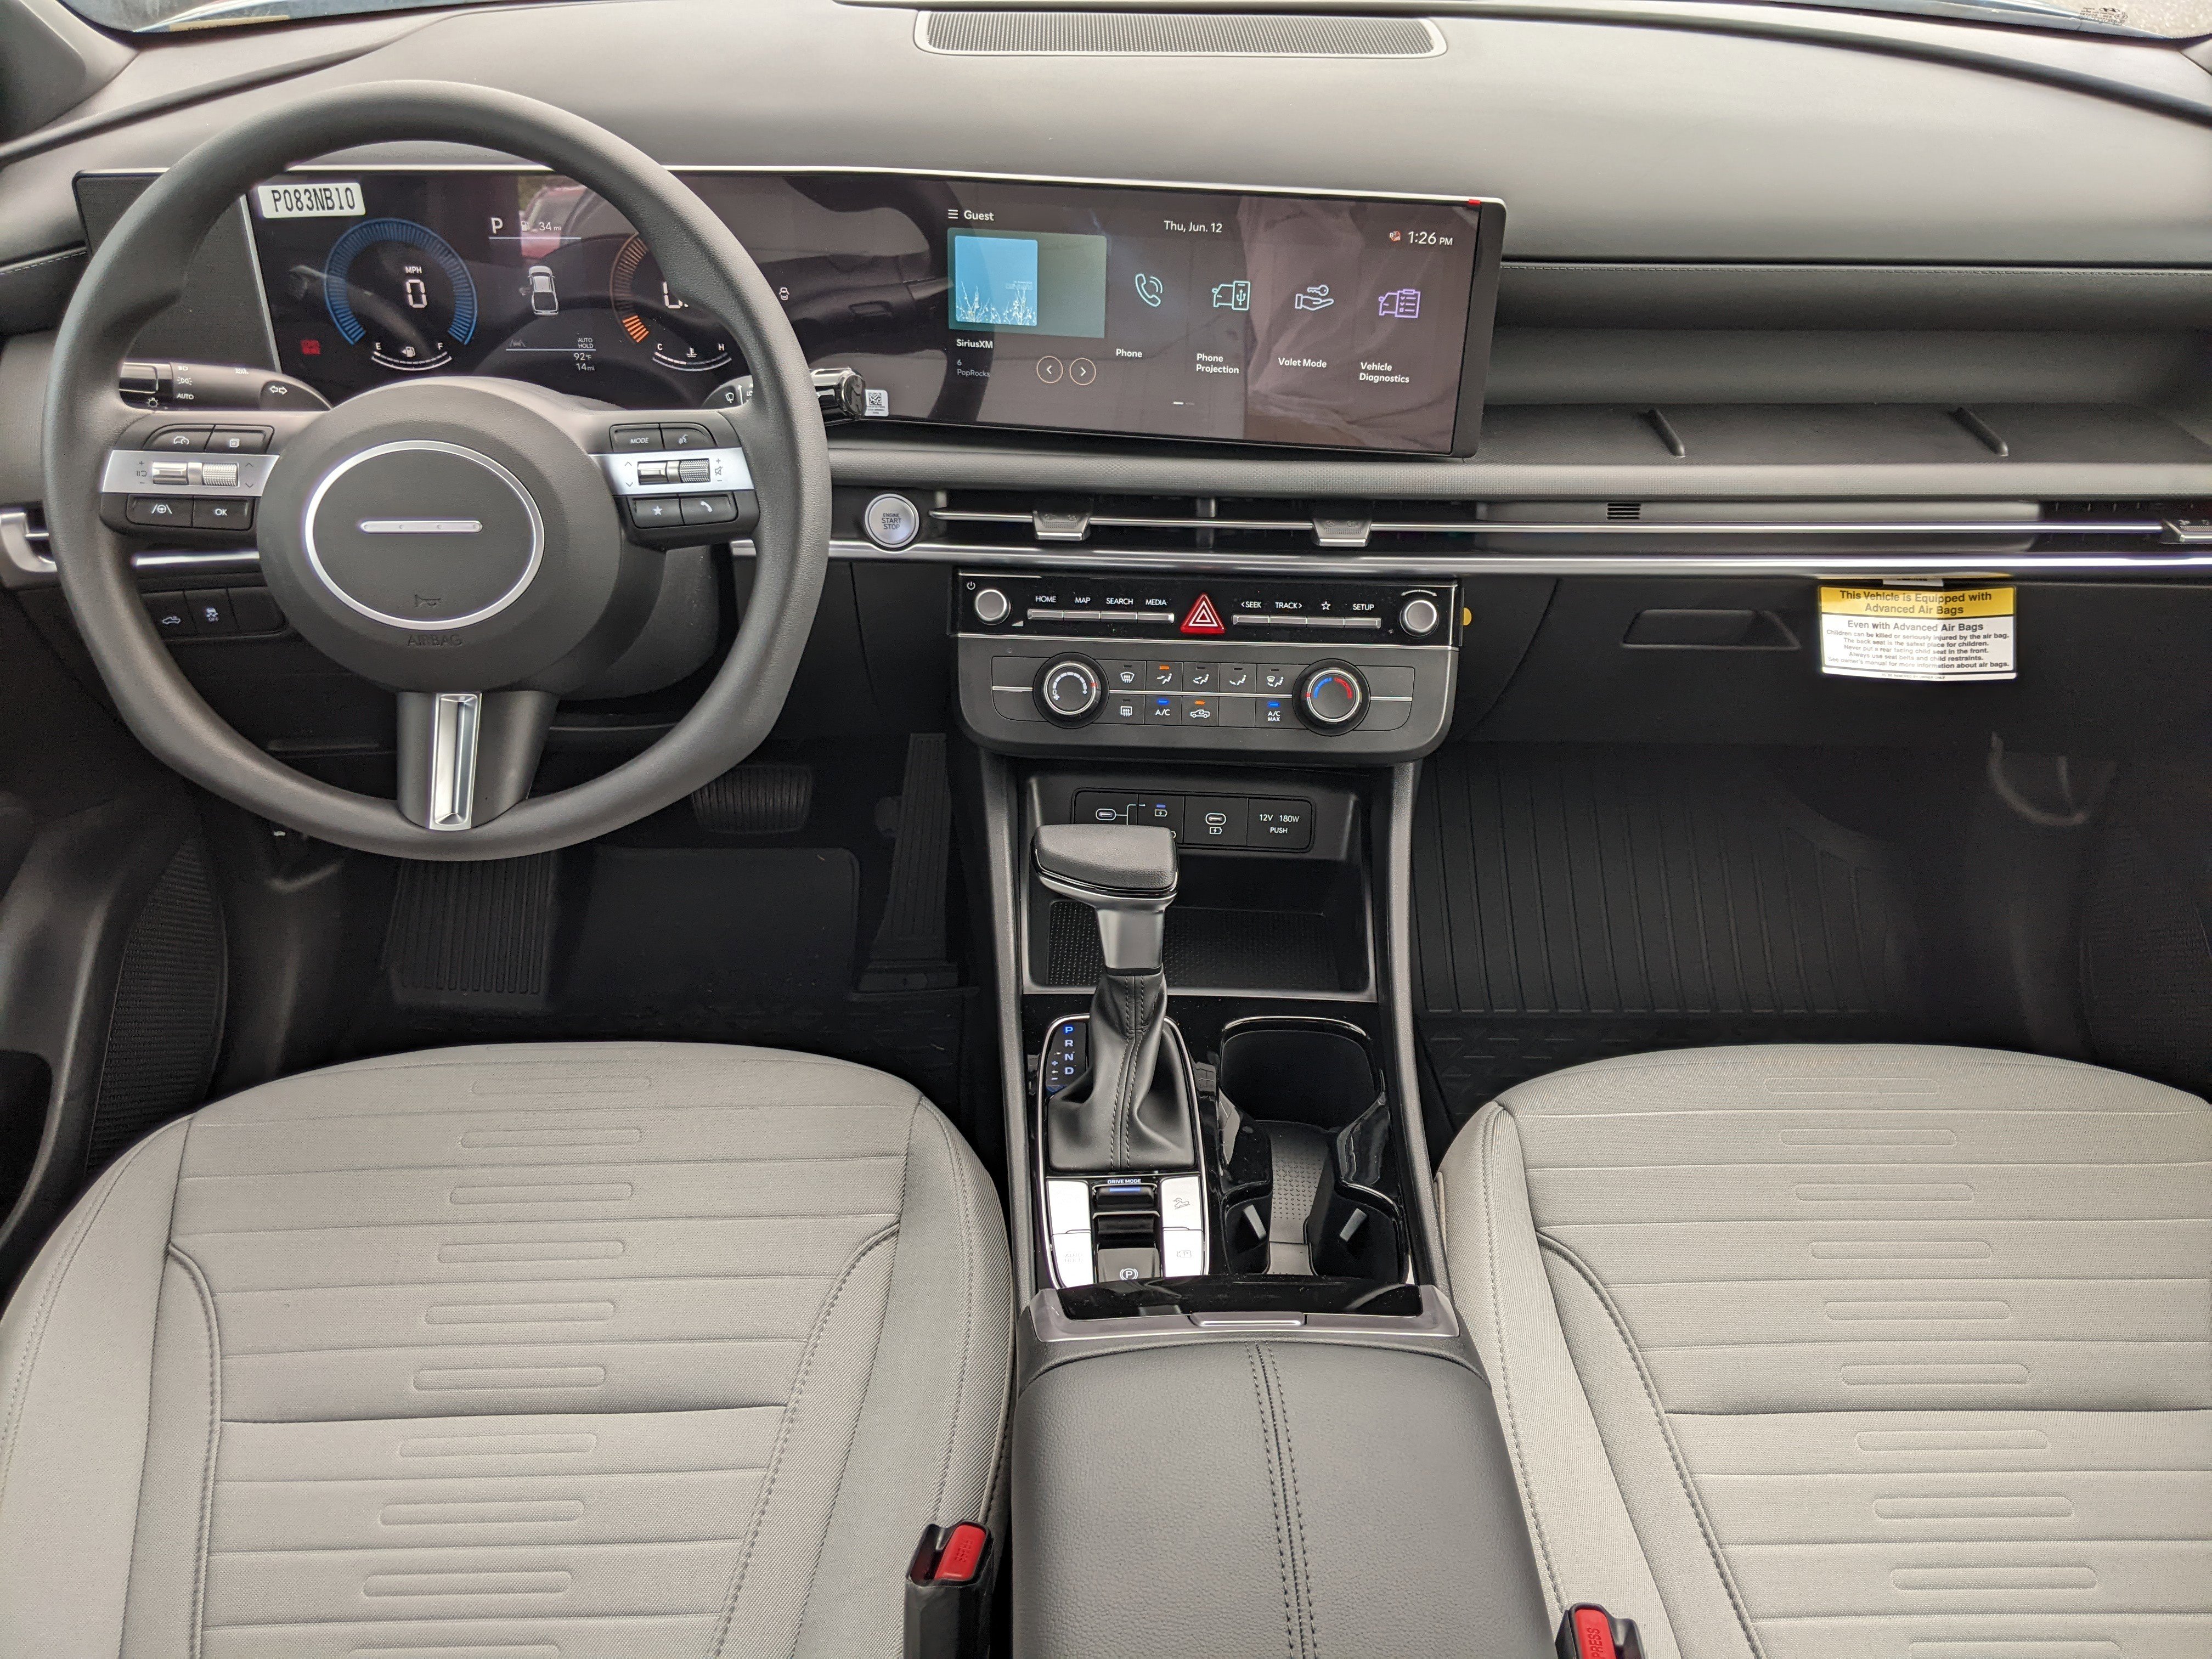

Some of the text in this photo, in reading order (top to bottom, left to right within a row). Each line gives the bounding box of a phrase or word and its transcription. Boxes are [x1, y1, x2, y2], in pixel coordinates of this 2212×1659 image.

[963, 211, 995, 221] Guest
[491, 218, 503, 234] P
[1164, 221, 1223, 233] Thu, Jun. 12
[1408, 231, 1453, 245] 1:26 PM
[407, 279, 427, 308] 0
[956, 338, 994, 349] SiriusXM
[1116, 349, 1143, 358] Phone
[1197, 353, 1224, 363] Phone
[1278, 358, 1327, 368] Valet Mode
[1360, 362, 1392, 371] Vehicle
[957, 369, 991, 378] PopRocks
[1196, 364, 1239, 375] Projection
[1359, 373, 1410, 384] Diagnostics
[215, 508, 228, 516] OK
[1839, 590, 1992, 604] This Vehicle is Equipped with
[1865, 603, 1963, 616] Advanced Air Bags
[1848, 620, 1869, 628] Even
[1872, 622, 1890, 630] with
[1893, 623, 1938, 631] Advanced
[1959, 623, 1983, 633] Bags
[408, 633, 464, 647] AIRBAG
[1587, 1627, 1604, 1659] PRESS
